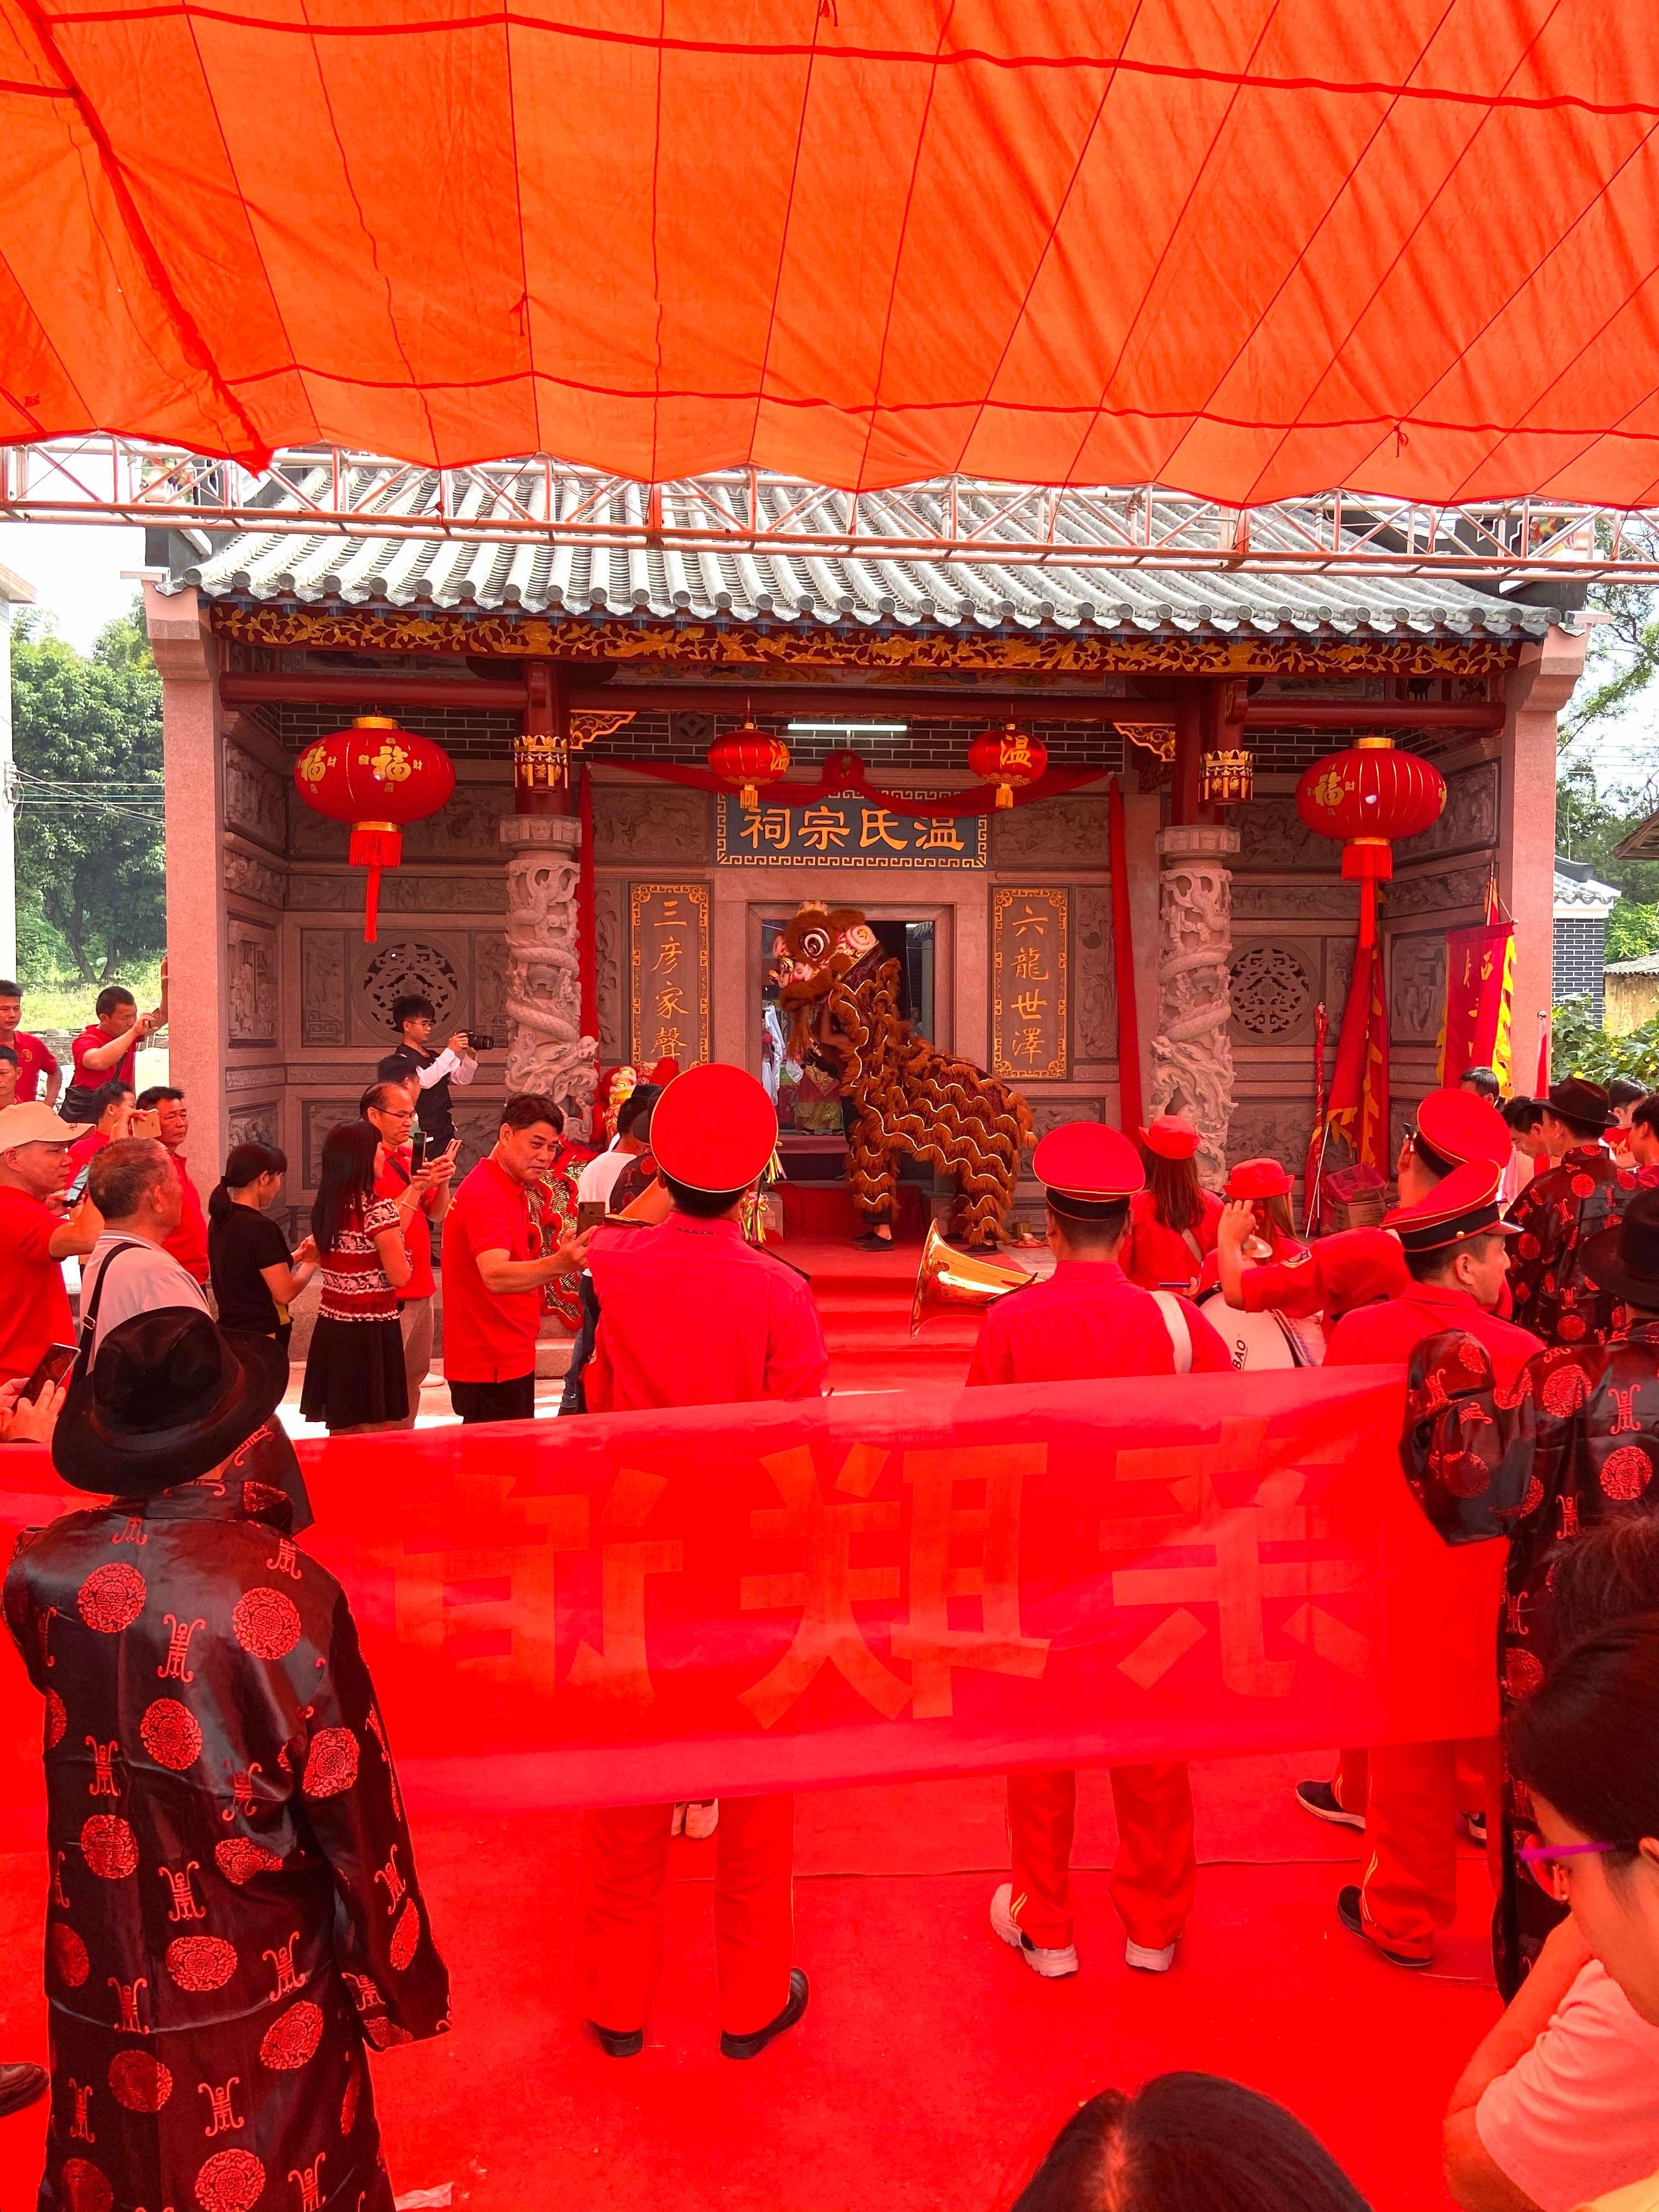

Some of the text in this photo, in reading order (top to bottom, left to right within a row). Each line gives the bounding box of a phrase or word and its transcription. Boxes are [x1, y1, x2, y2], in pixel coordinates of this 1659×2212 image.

[301, 746, 327, 782] 福
[371, 745, 411, 781] 福
[1000, 735, 1032, 768] 温
[1312, 771, 1344, 806] 福
[1011, 905, 1049, 1064] 六龍世澤
